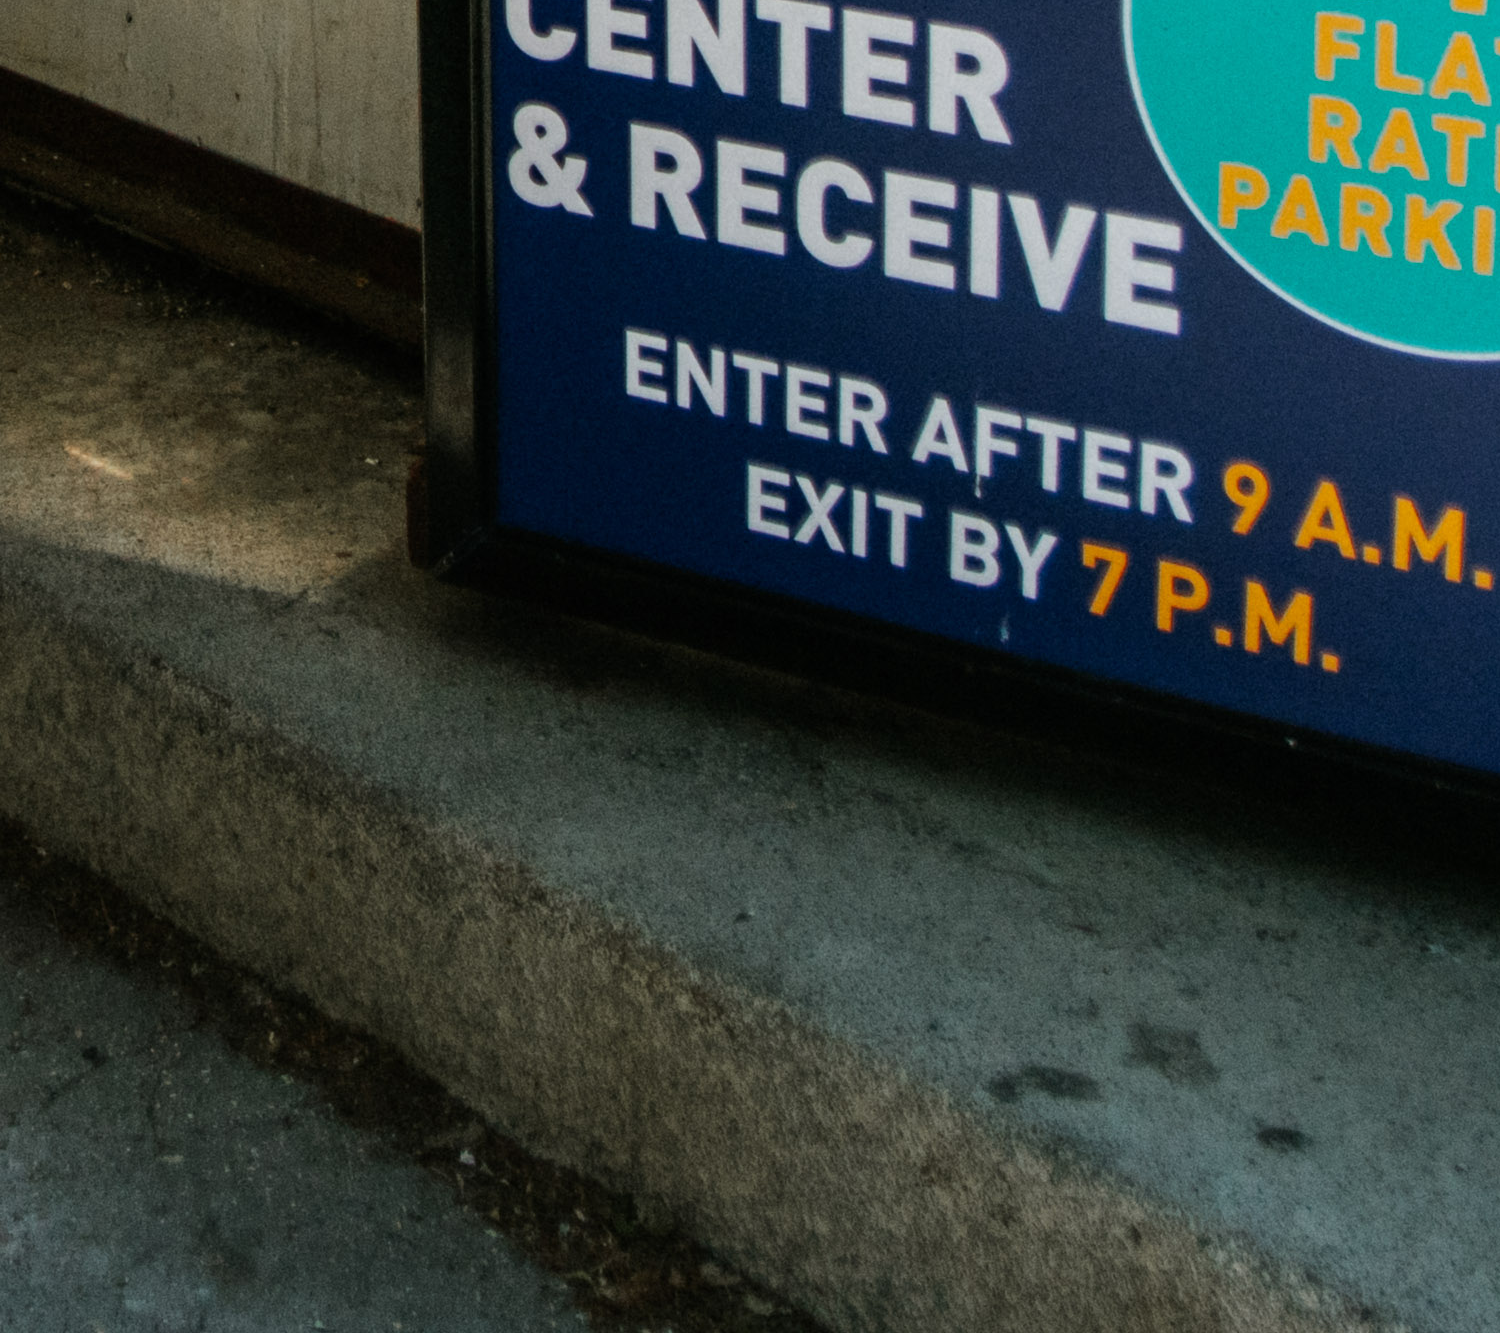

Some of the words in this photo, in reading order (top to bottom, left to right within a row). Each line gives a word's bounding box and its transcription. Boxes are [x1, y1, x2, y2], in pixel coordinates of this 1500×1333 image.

[506, 101, 594, 221] &
[627, 120, 1186, 337] RECEIVE
[622, 326, 891, 459] ENTER
[910, 395, 1198, 527] AFTER
[1220, 460, 1272, 537] 9
[1292, 476, 1499, 593] A.M.
[743, 462, 923, 574] EXIT
[948, 495, 1062, 606] BY
[1079, 539, 1130, 622] 7
[1152, 556, 1344, 677] P.M.
